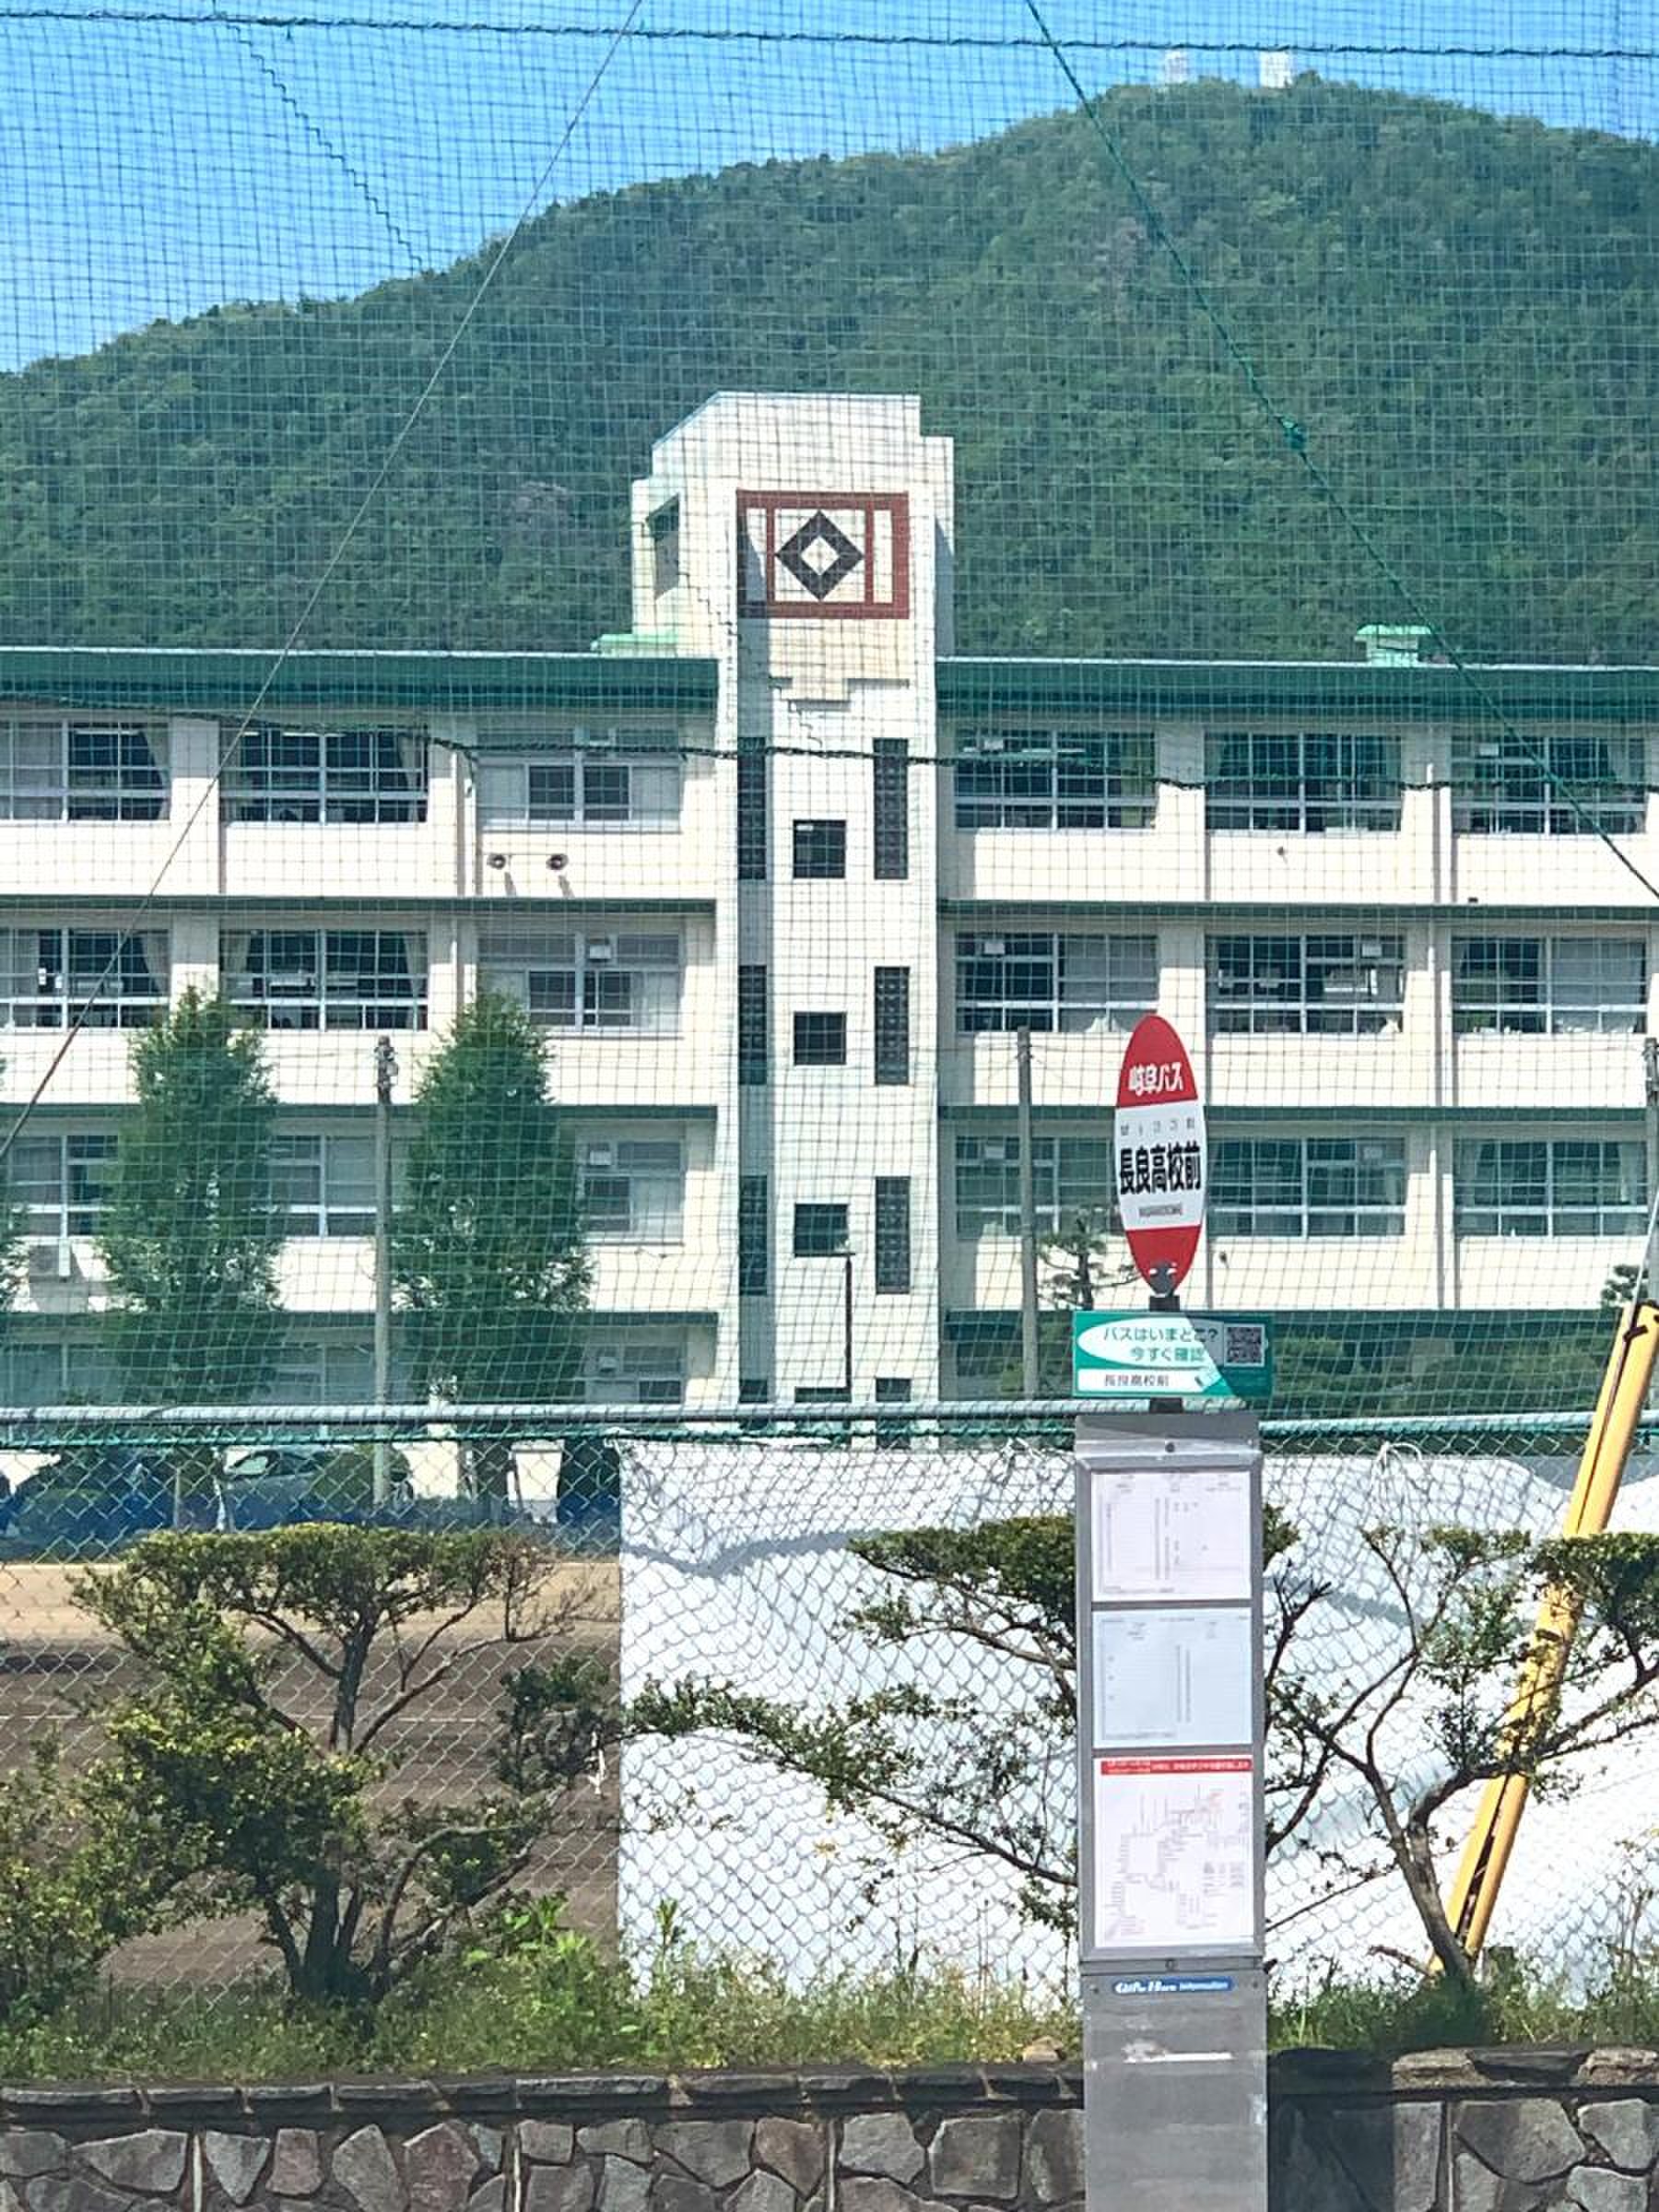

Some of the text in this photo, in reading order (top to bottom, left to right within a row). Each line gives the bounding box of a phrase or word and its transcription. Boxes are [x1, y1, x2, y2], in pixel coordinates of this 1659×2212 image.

[1128, 1062, 1183, 1095] 岐阜バス
[1120, 1140, 1201, 1194] 長良高校前
[1129, 1347, 1206, 1361] 今すぐ確認
